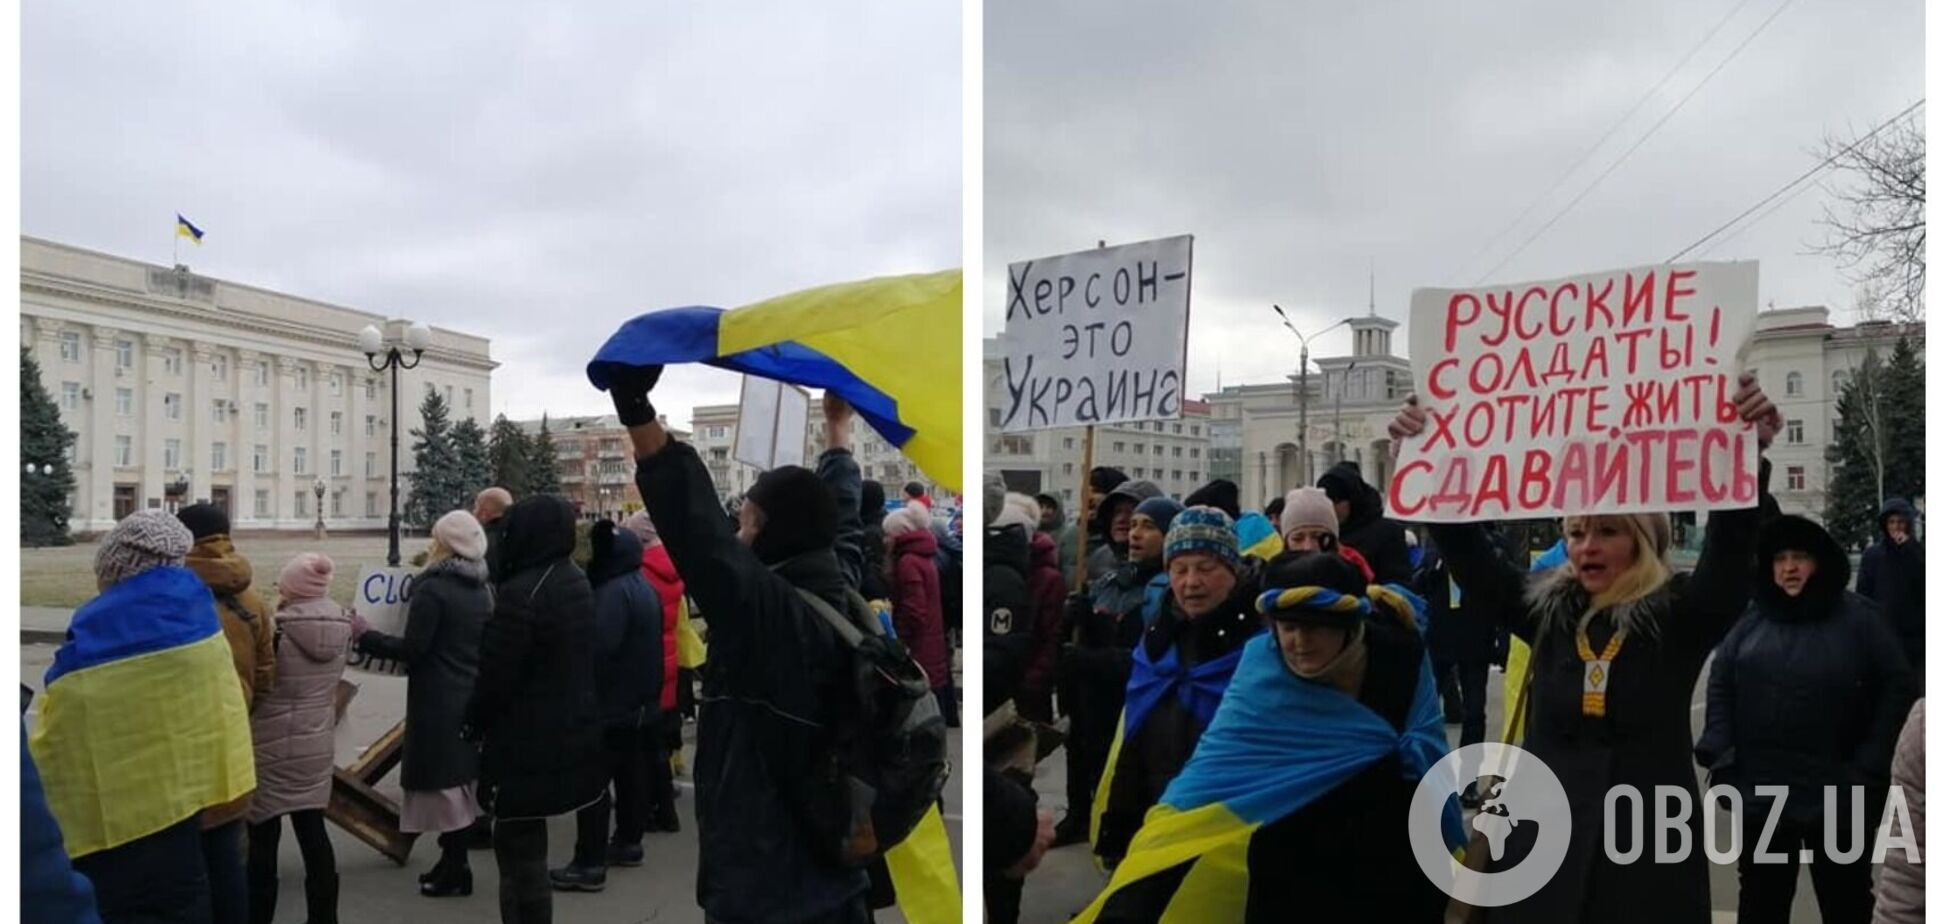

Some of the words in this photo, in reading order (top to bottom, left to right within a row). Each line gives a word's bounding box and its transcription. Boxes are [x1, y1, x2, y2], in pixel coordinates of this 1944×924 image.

[1428, 306, 1721, 400] СОЛДАТЫ!
[1445, 270, 1696, 353] РУССКИЕ
[1421, 385, 1609, 453] ХОТИТЕ
[1389, 428, 1756, 516] СДАВАЙТЕСЬ
[364, 573, 415, 604] CLO
